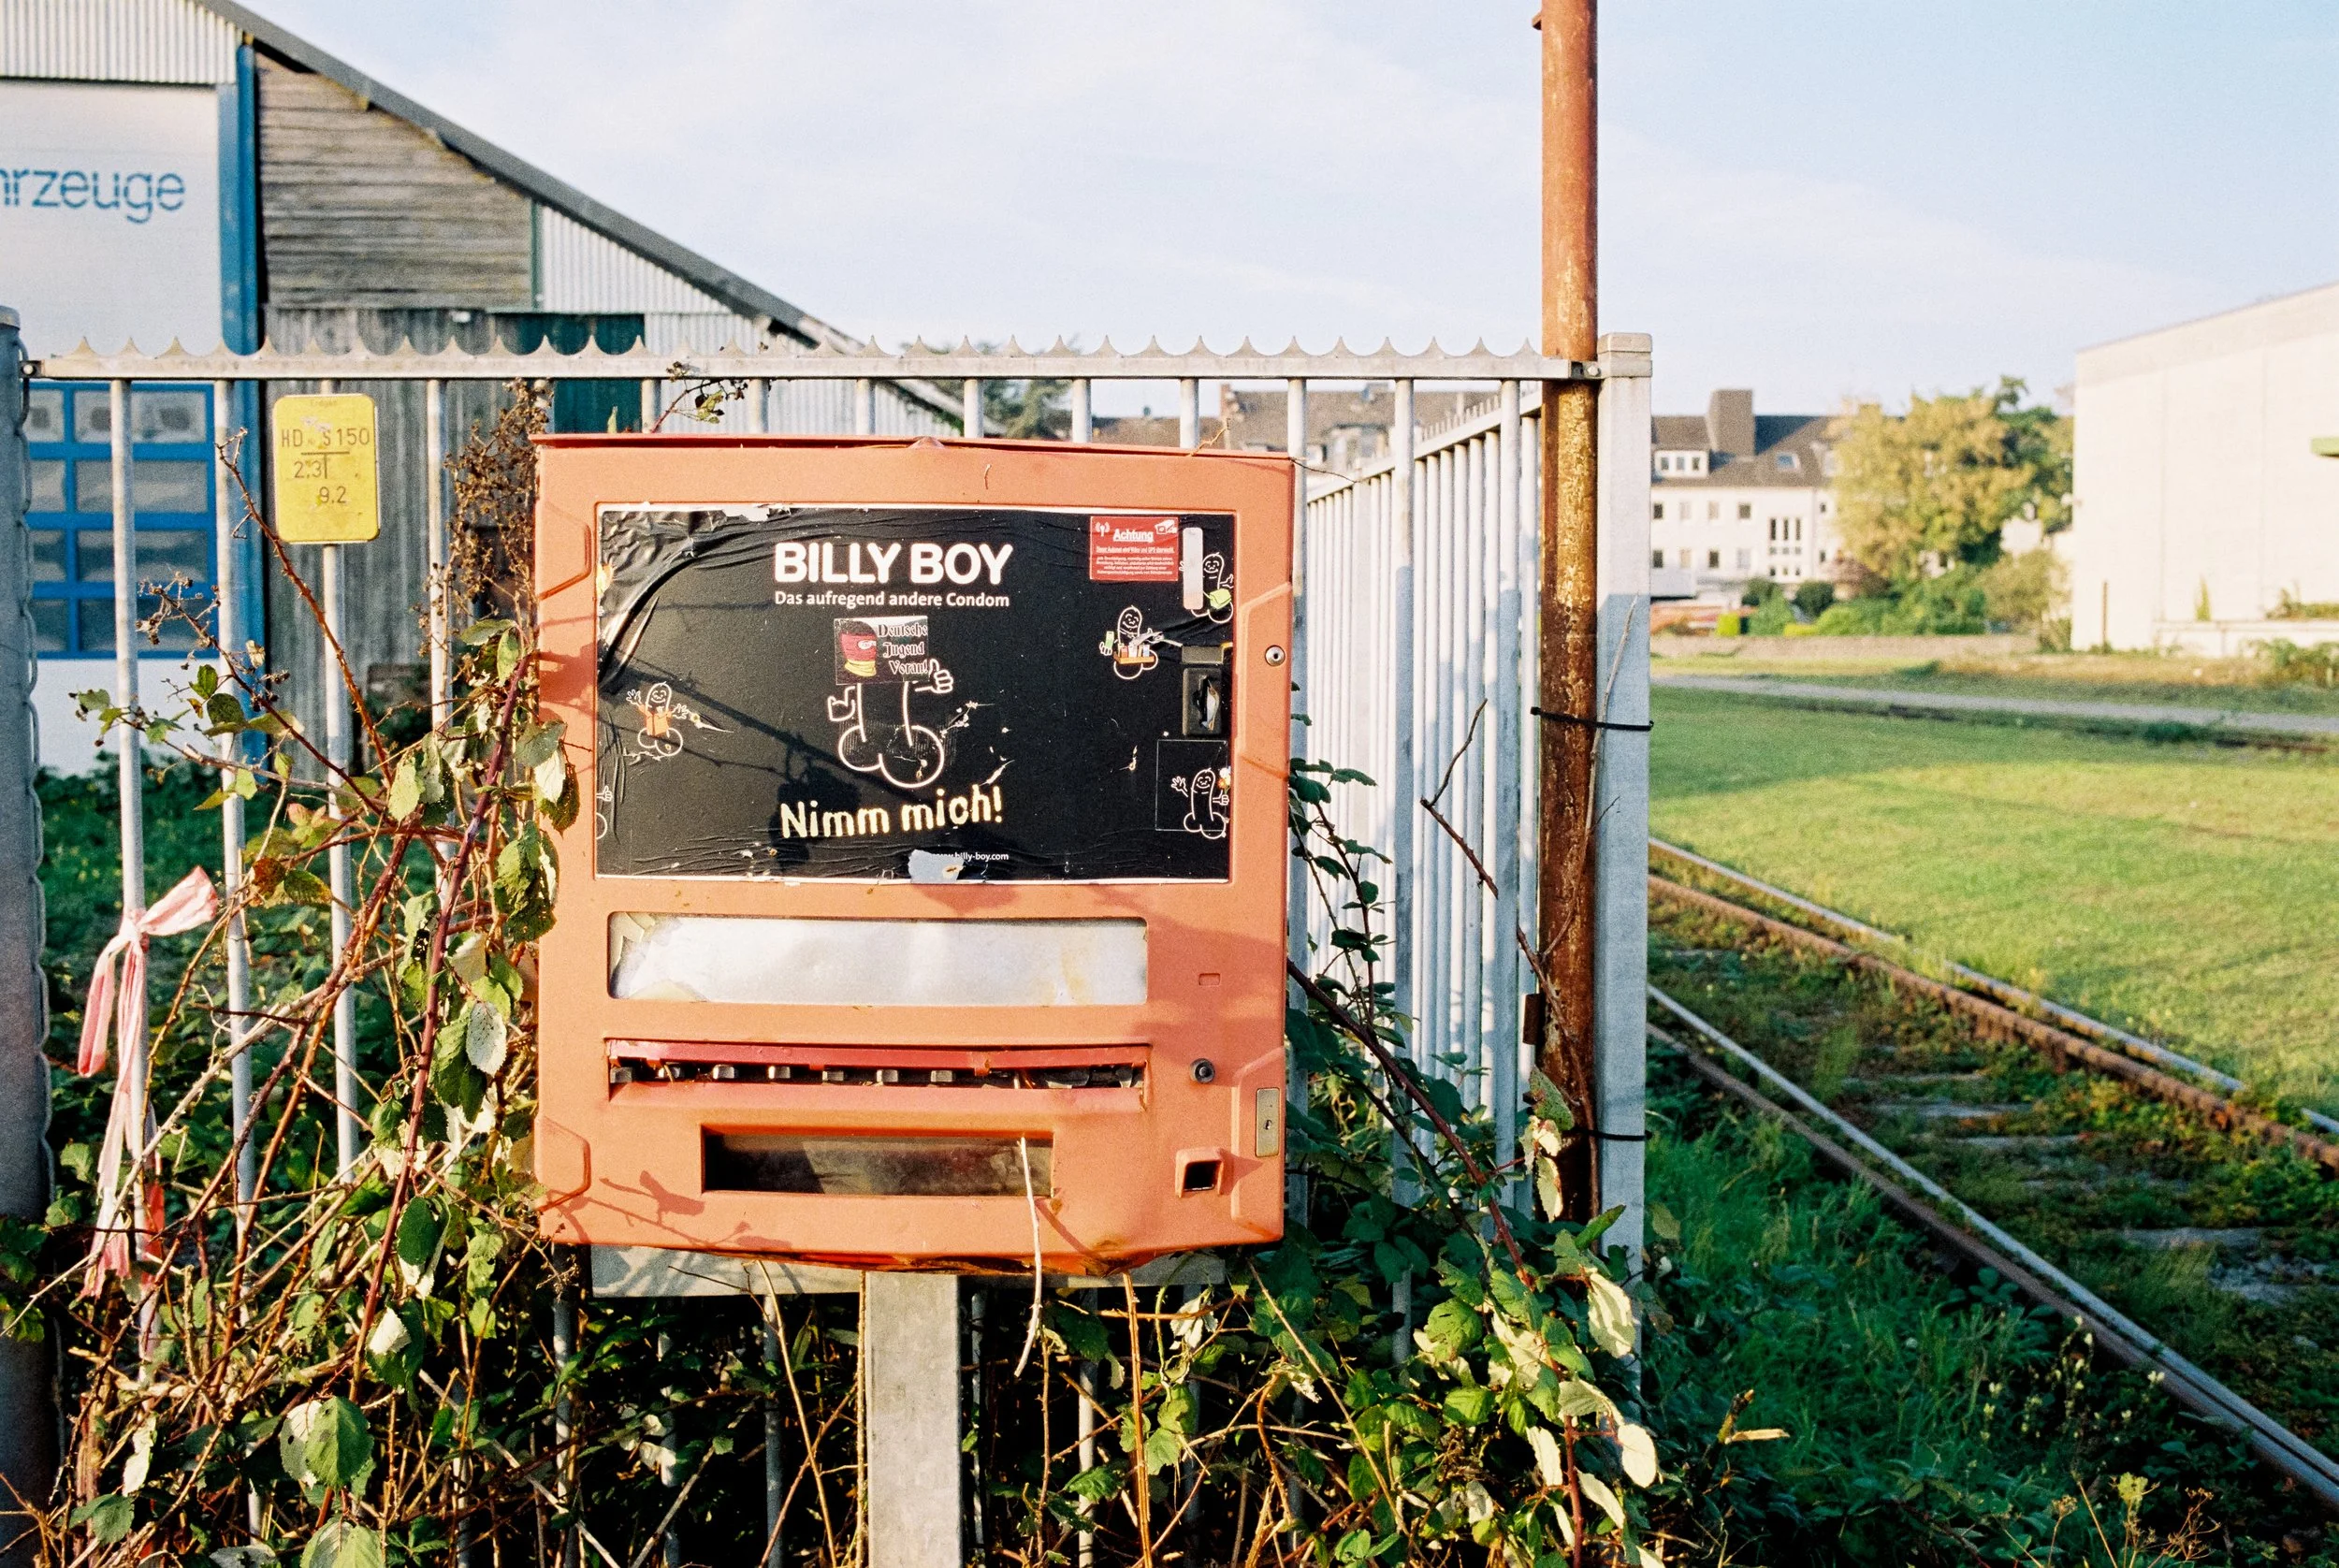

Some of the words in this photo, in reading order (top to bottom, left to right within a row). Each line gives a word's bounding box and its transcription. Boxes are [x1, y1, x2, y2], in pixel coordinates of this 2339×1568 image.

[281, 428, 303, 448] HD
[1112, 528, 1154, 544] Achtung
[775, 542, 902, 584] BILLY
[909, 543, 1014, 585] BOY
[775, 590, 803, 606] Das
[806, 590, 885, 609] aufregend
[889, 591, 942, 607] andere
[945, 592, 1010, 607] Condom
[877, 622, 928, 638] Deutsche
[882, 641, 925, 660] Jugend
[888, 659, 929, 675] Voran!
[780, 800, 890, 839] Nimm
[901, 784, 1003, 832] mich!
[937, 851, 1010, 863] billy-boy.com
